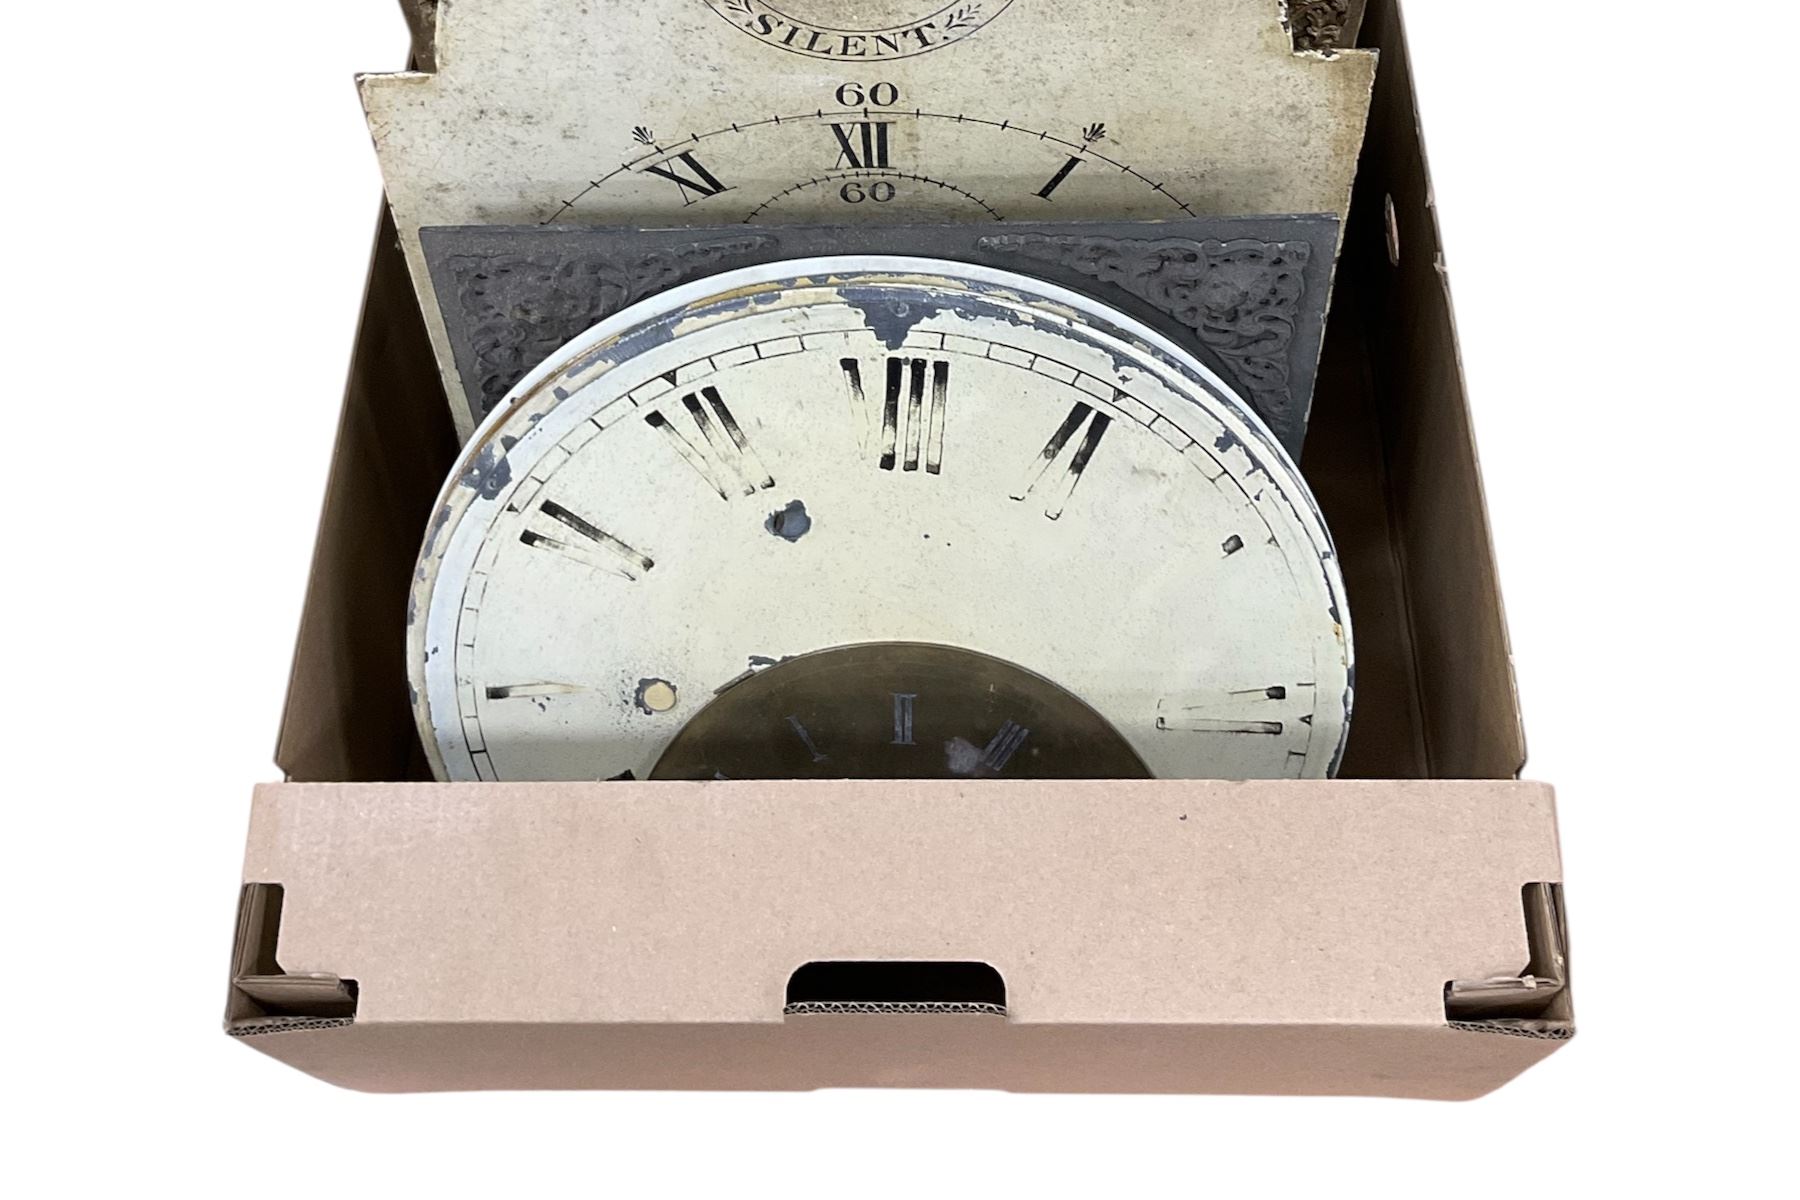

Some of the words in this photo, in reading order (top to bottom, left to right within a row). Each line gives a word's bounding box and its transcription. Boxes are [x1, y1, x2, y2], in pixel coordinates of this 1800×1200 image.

[836, 81, 899, 107] 60
[820, 121, 897, 171] XII
[636, 148, 738, 207] XI
[840, 181, 896, 204] 60
[1030, 152, 1087, 202] I
